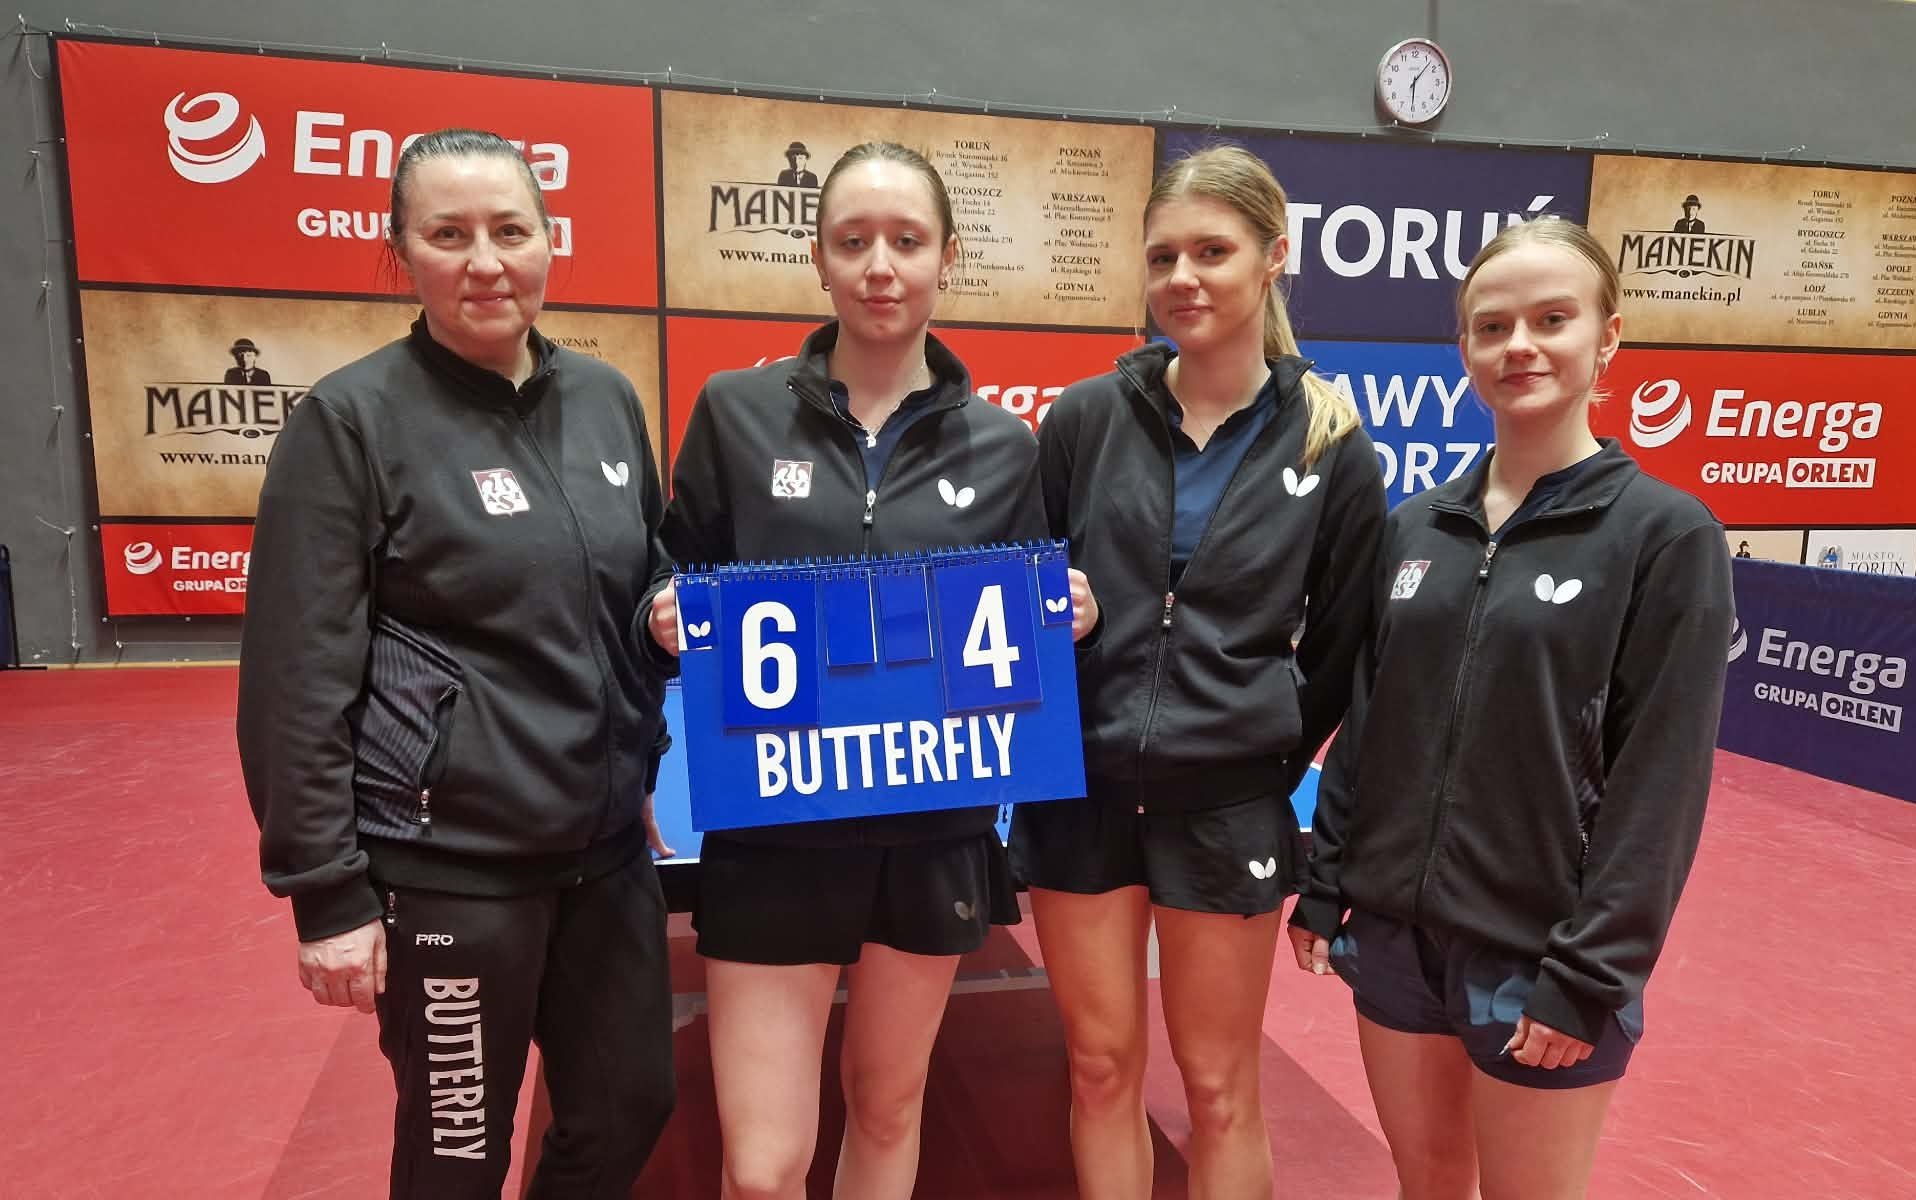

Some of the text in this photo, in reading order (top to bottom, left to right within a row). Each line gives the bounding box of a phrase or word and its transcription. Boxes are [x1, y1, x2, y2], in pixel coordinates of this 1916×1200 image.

[1431, 65, 1437, 73] 2
[294, 111, 569, 190] Ena
[1051, 192, 1106, 203] WARSZAWA
[297, 208, 391, 241] GRU
[1060, 229, 1094, 238] OPOLE
[1285, 195, 1561, 281] TORU
[719, 249, 816, 265] www.man
[1051, 255, 1101, 265] SZCZECIN
[1618, 234, 1756, 280] MANEKIN
[1055, 282, 1095, 292] GDYNIA
[1622, 286, 1741, 306] www.manekin.pl
[1705, 389, 1883, 453] Energa
[1701, 462, 1870, 484] GRUPA ORLEN
[173, 580, 225, 591] GRUPA
[962, 584, 1020, 689] 4
[741, 601, 798, 710] 6
[1757, 627, 1907, 695] Energa
[1753, 682, 1897, 728] GRUPA ORLEN
[755, 712, 1016, 798] BUTTERFLY
[415, 933, 454, 946] PRO
[423, 977, 487, 1160] BUTTERFLY
